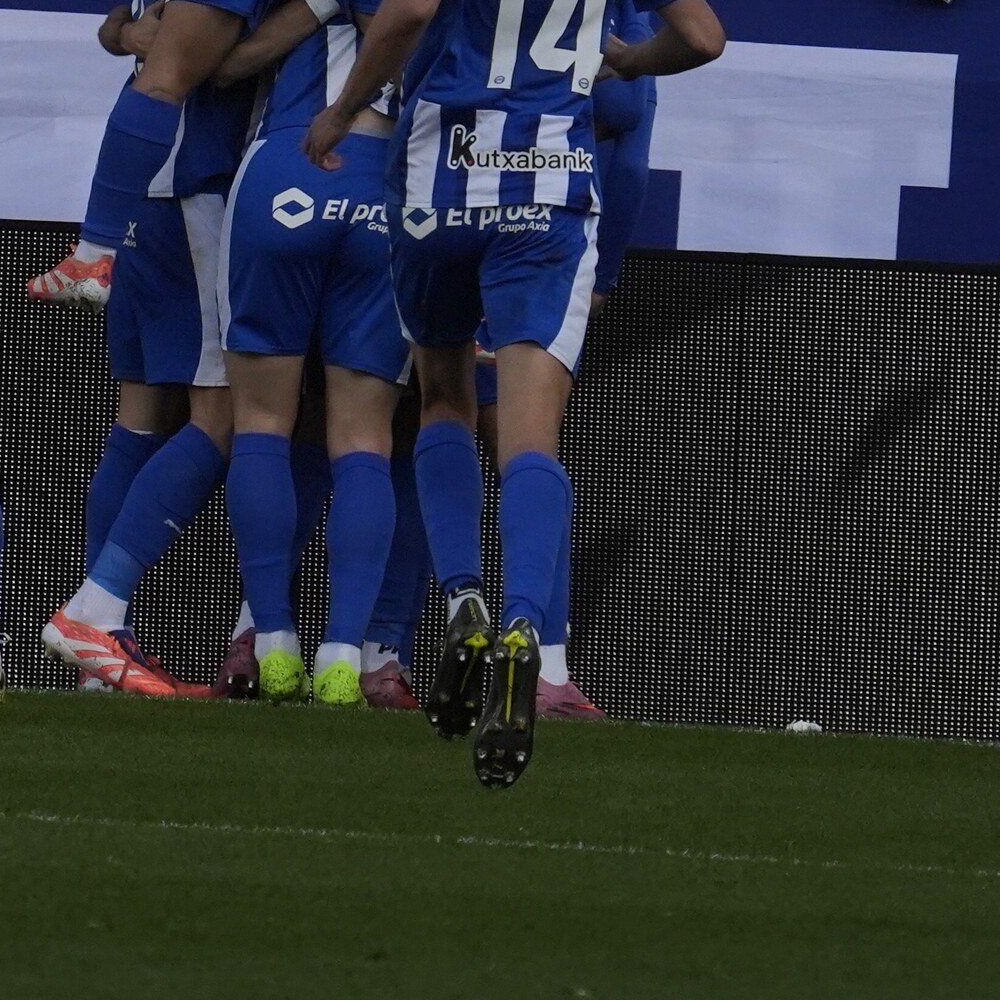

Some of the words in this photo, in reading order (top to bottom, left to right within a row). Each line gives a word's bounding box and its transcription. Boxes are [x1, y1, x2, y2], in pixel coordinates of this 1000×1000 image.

[448, 124, 593, 172] Kutxabank
[322, 199, 349, 220] El
[479, 204, 552, 230] proex
